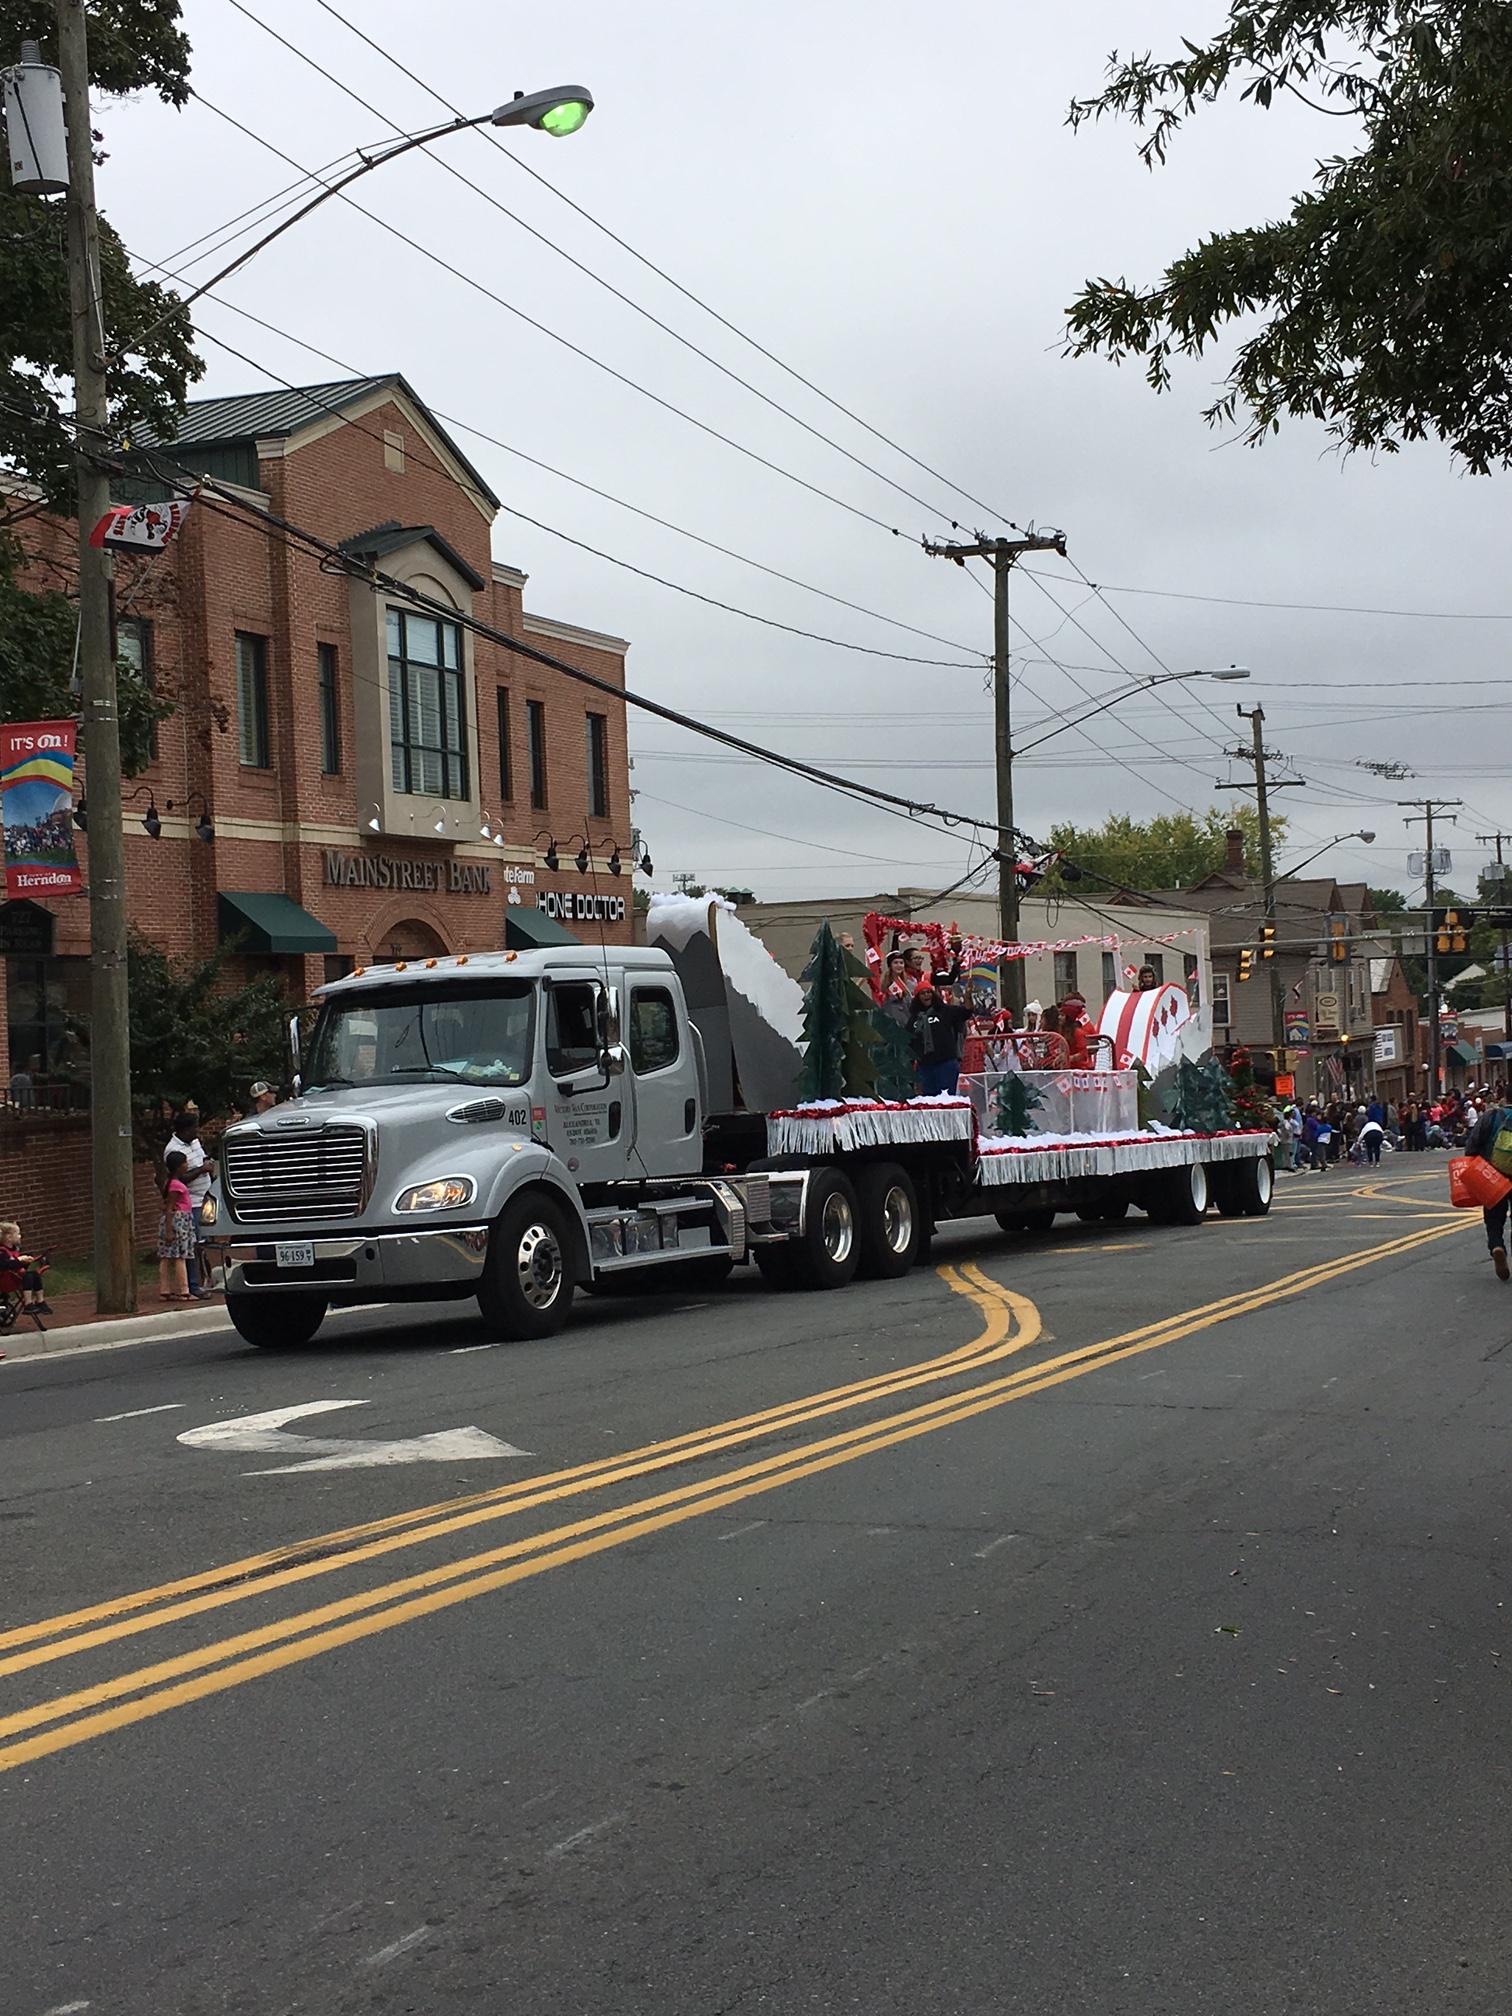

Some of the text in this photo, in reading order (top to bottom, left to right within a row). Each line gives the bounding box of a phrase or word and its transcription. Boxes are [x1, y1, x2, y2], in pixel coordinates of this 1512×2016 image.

[10, 736, 34, 751] IT'S
[16, 872, 72, 887] Herndon
[535, 892, 626, 921] HONE DOCTOR
[508, 1110, 527, 1126] 402
